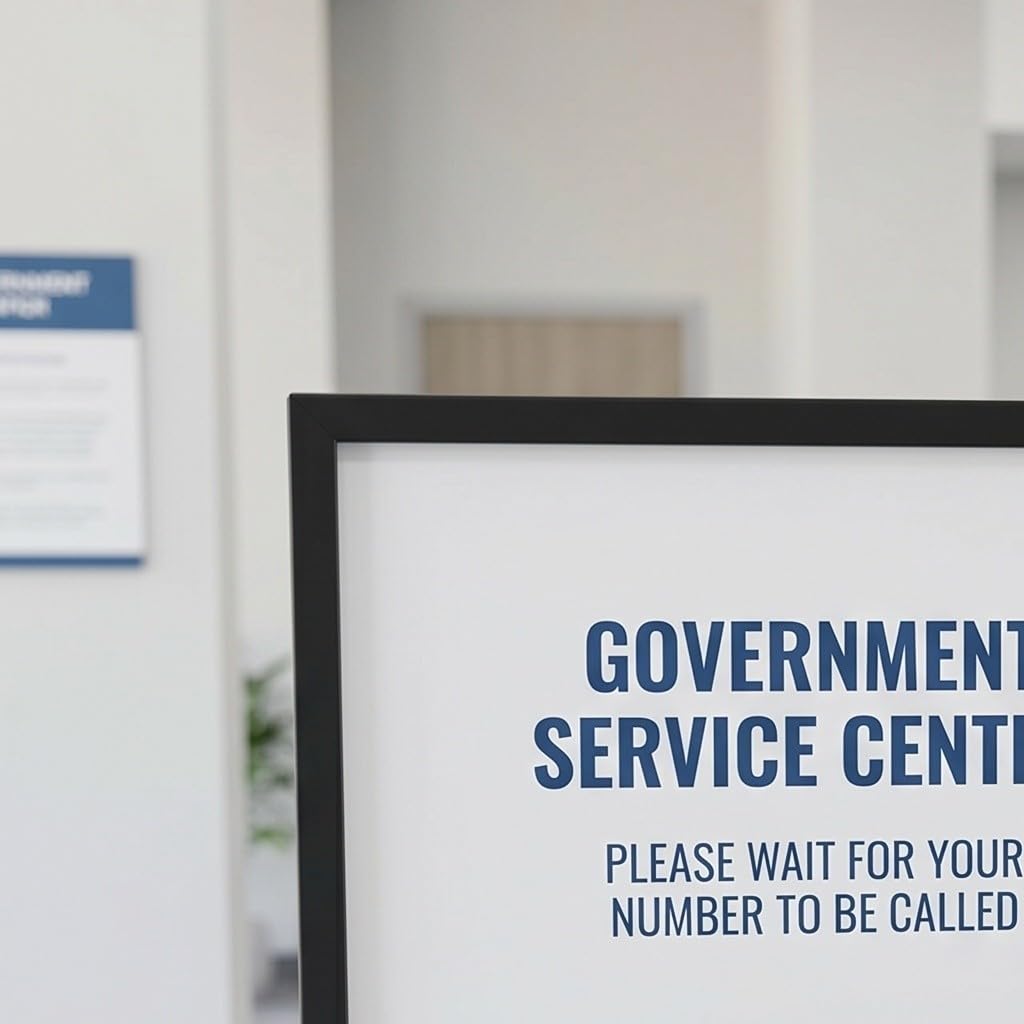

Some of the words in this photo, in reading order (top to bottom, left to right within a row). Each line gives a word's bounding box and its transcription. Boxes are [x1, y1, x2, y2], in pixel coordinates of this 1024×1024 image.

[533, 716, 818, 789] SERVICE
[606, 842, 735, 884] PLEASE
[748, 841, 835, 881] WAIT
[848, 840, 914, 880] FOR
[928, 839, 1023, 879] YOUR
[611, 895, 763, 937] NUMBER
[776, 894, 821, 935] TO
[835, 893, 877, 933] BE
[890, 892, 1019, 933] CALLED
